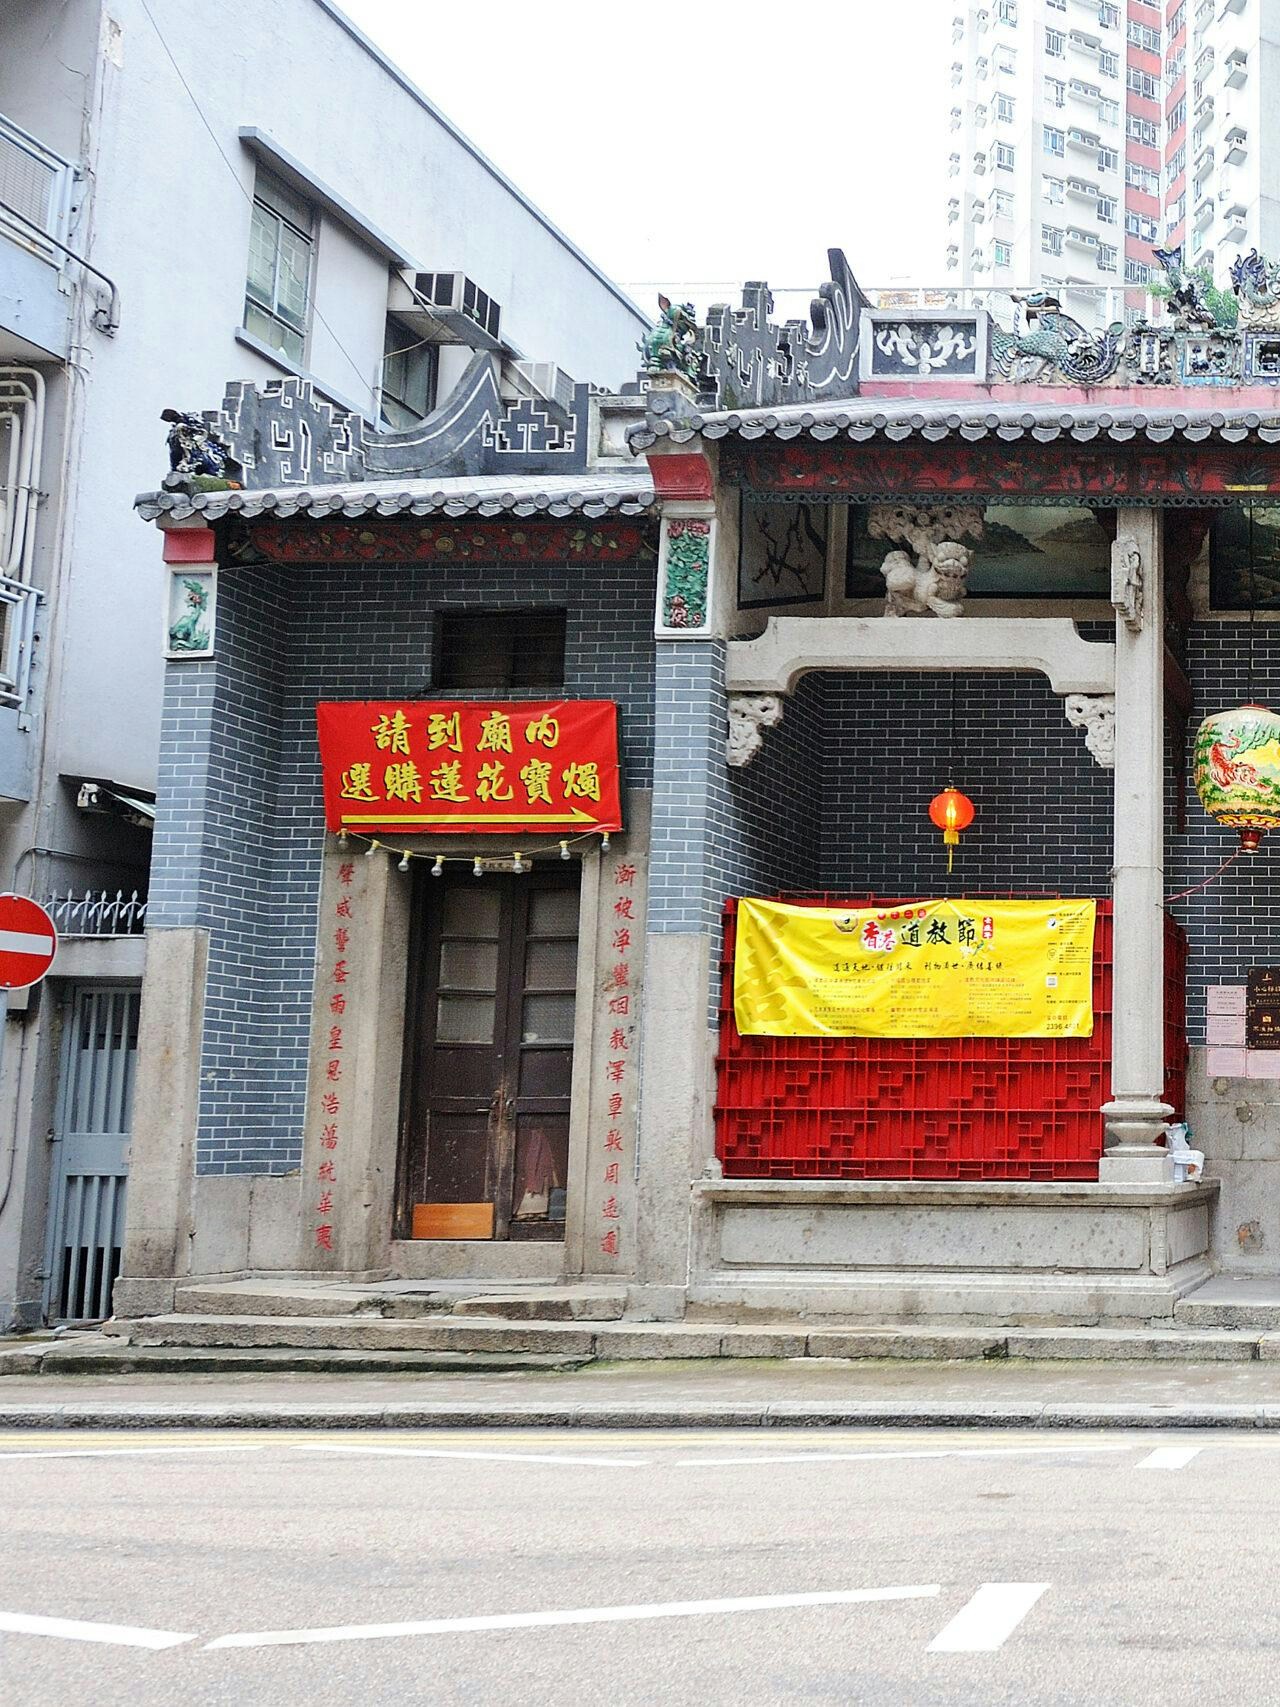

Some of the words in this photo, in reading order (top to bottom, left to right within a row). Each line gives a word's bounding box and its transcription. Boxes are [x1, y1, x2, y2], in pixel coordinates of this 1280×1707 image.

[371, 709, 561, 755] 請到廟內
[340, 759, 602, 804] 選購蓮花寶燭
[863, 918, 976, 951] 香港道教節
